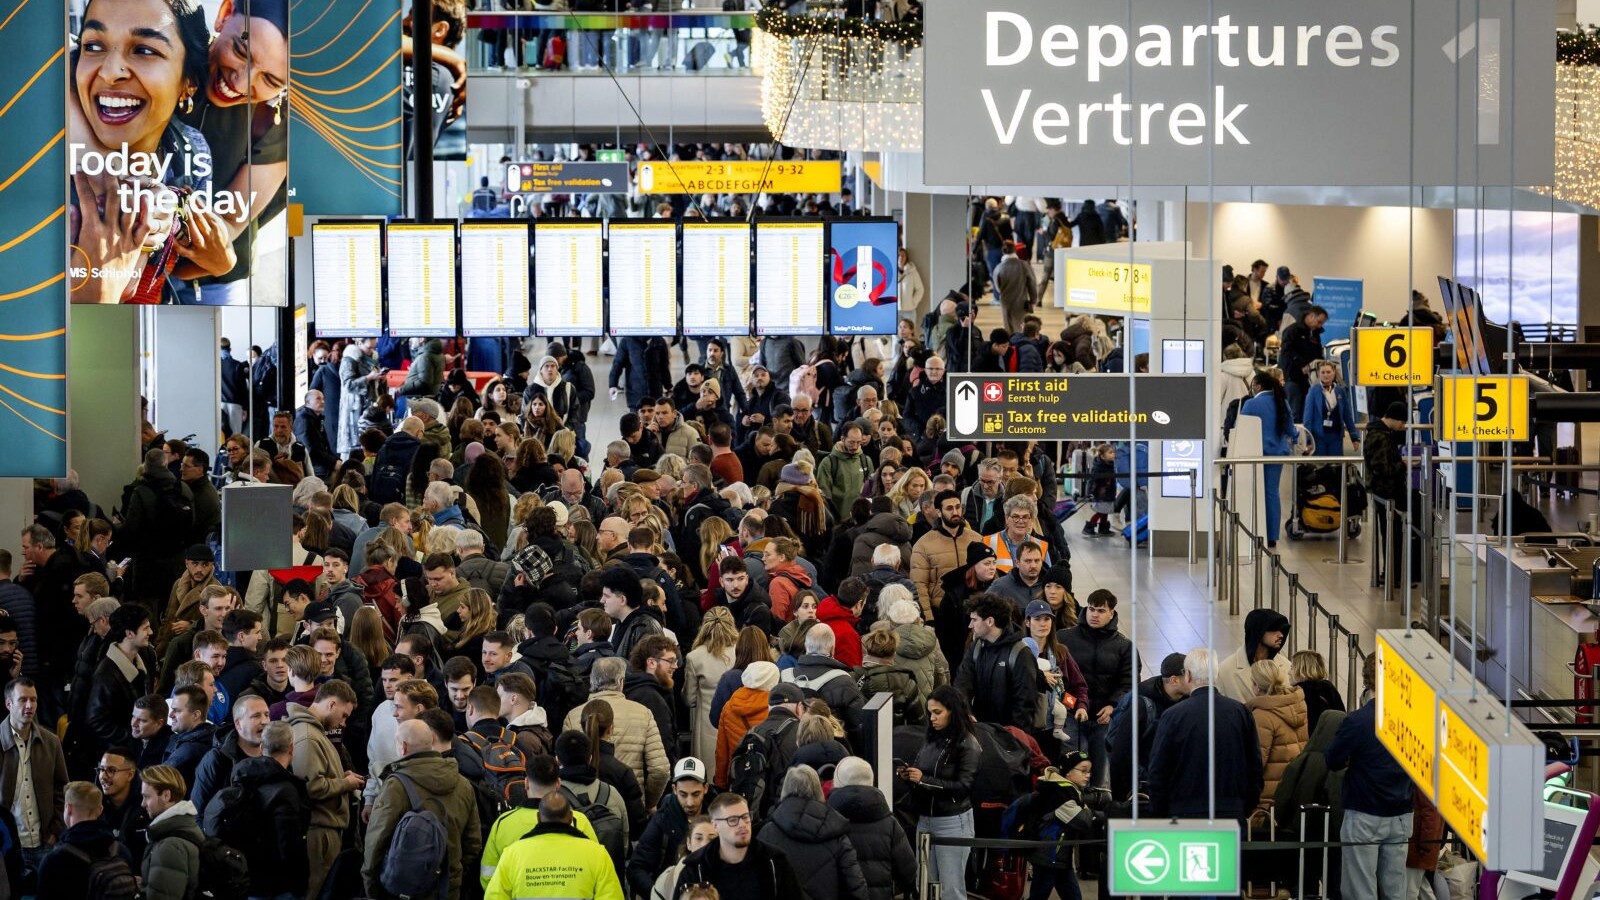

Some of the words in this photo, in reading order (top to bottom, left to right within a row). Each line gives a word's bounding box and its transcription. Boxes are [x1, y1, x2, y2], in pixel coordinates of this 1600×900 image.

[986, 11, 1400, 82] Departures
[981, 85, 1250, 146] Vertrek
[69, 142, 173, 183] Today
[184, 143, 212, 177] is
[706, 165, 724, 175] 2-3
[777, 165, 804, 175] 9-32
[547, 178, 563, 186] free
[564, 178, 601, 186] validation
[117, 181, 178, 214] the
[189, 181, 258, 223] day
[91, 267, 142, 280] Schiphol
[1088, 267, 1112, 278] Check-in
[1113, 267, 1120, 281] 6
[1123, 268, 1129, 282] 7
[1133, 269, 1139, 283] 8
[1383, 333, 1407, 368] 6
[1383, 372, 1421, 381] Check-in
[1008, 379, 1040, 391] First
[1045, 379, 1068, 391] aid
[1008, 394, 1036, 403] Eerste
[1038, 394, 1060, 404] hulp
[1474, 382, 1498, 422] 5
[1007, 410, 1032, 423] Tax
[1037, 410, 1067, 423] free
[1072, 410, 1147, 423] validation
[1007, 425, 1047, 434] Customs
[1472, 426, 1515, 435] Check-in
